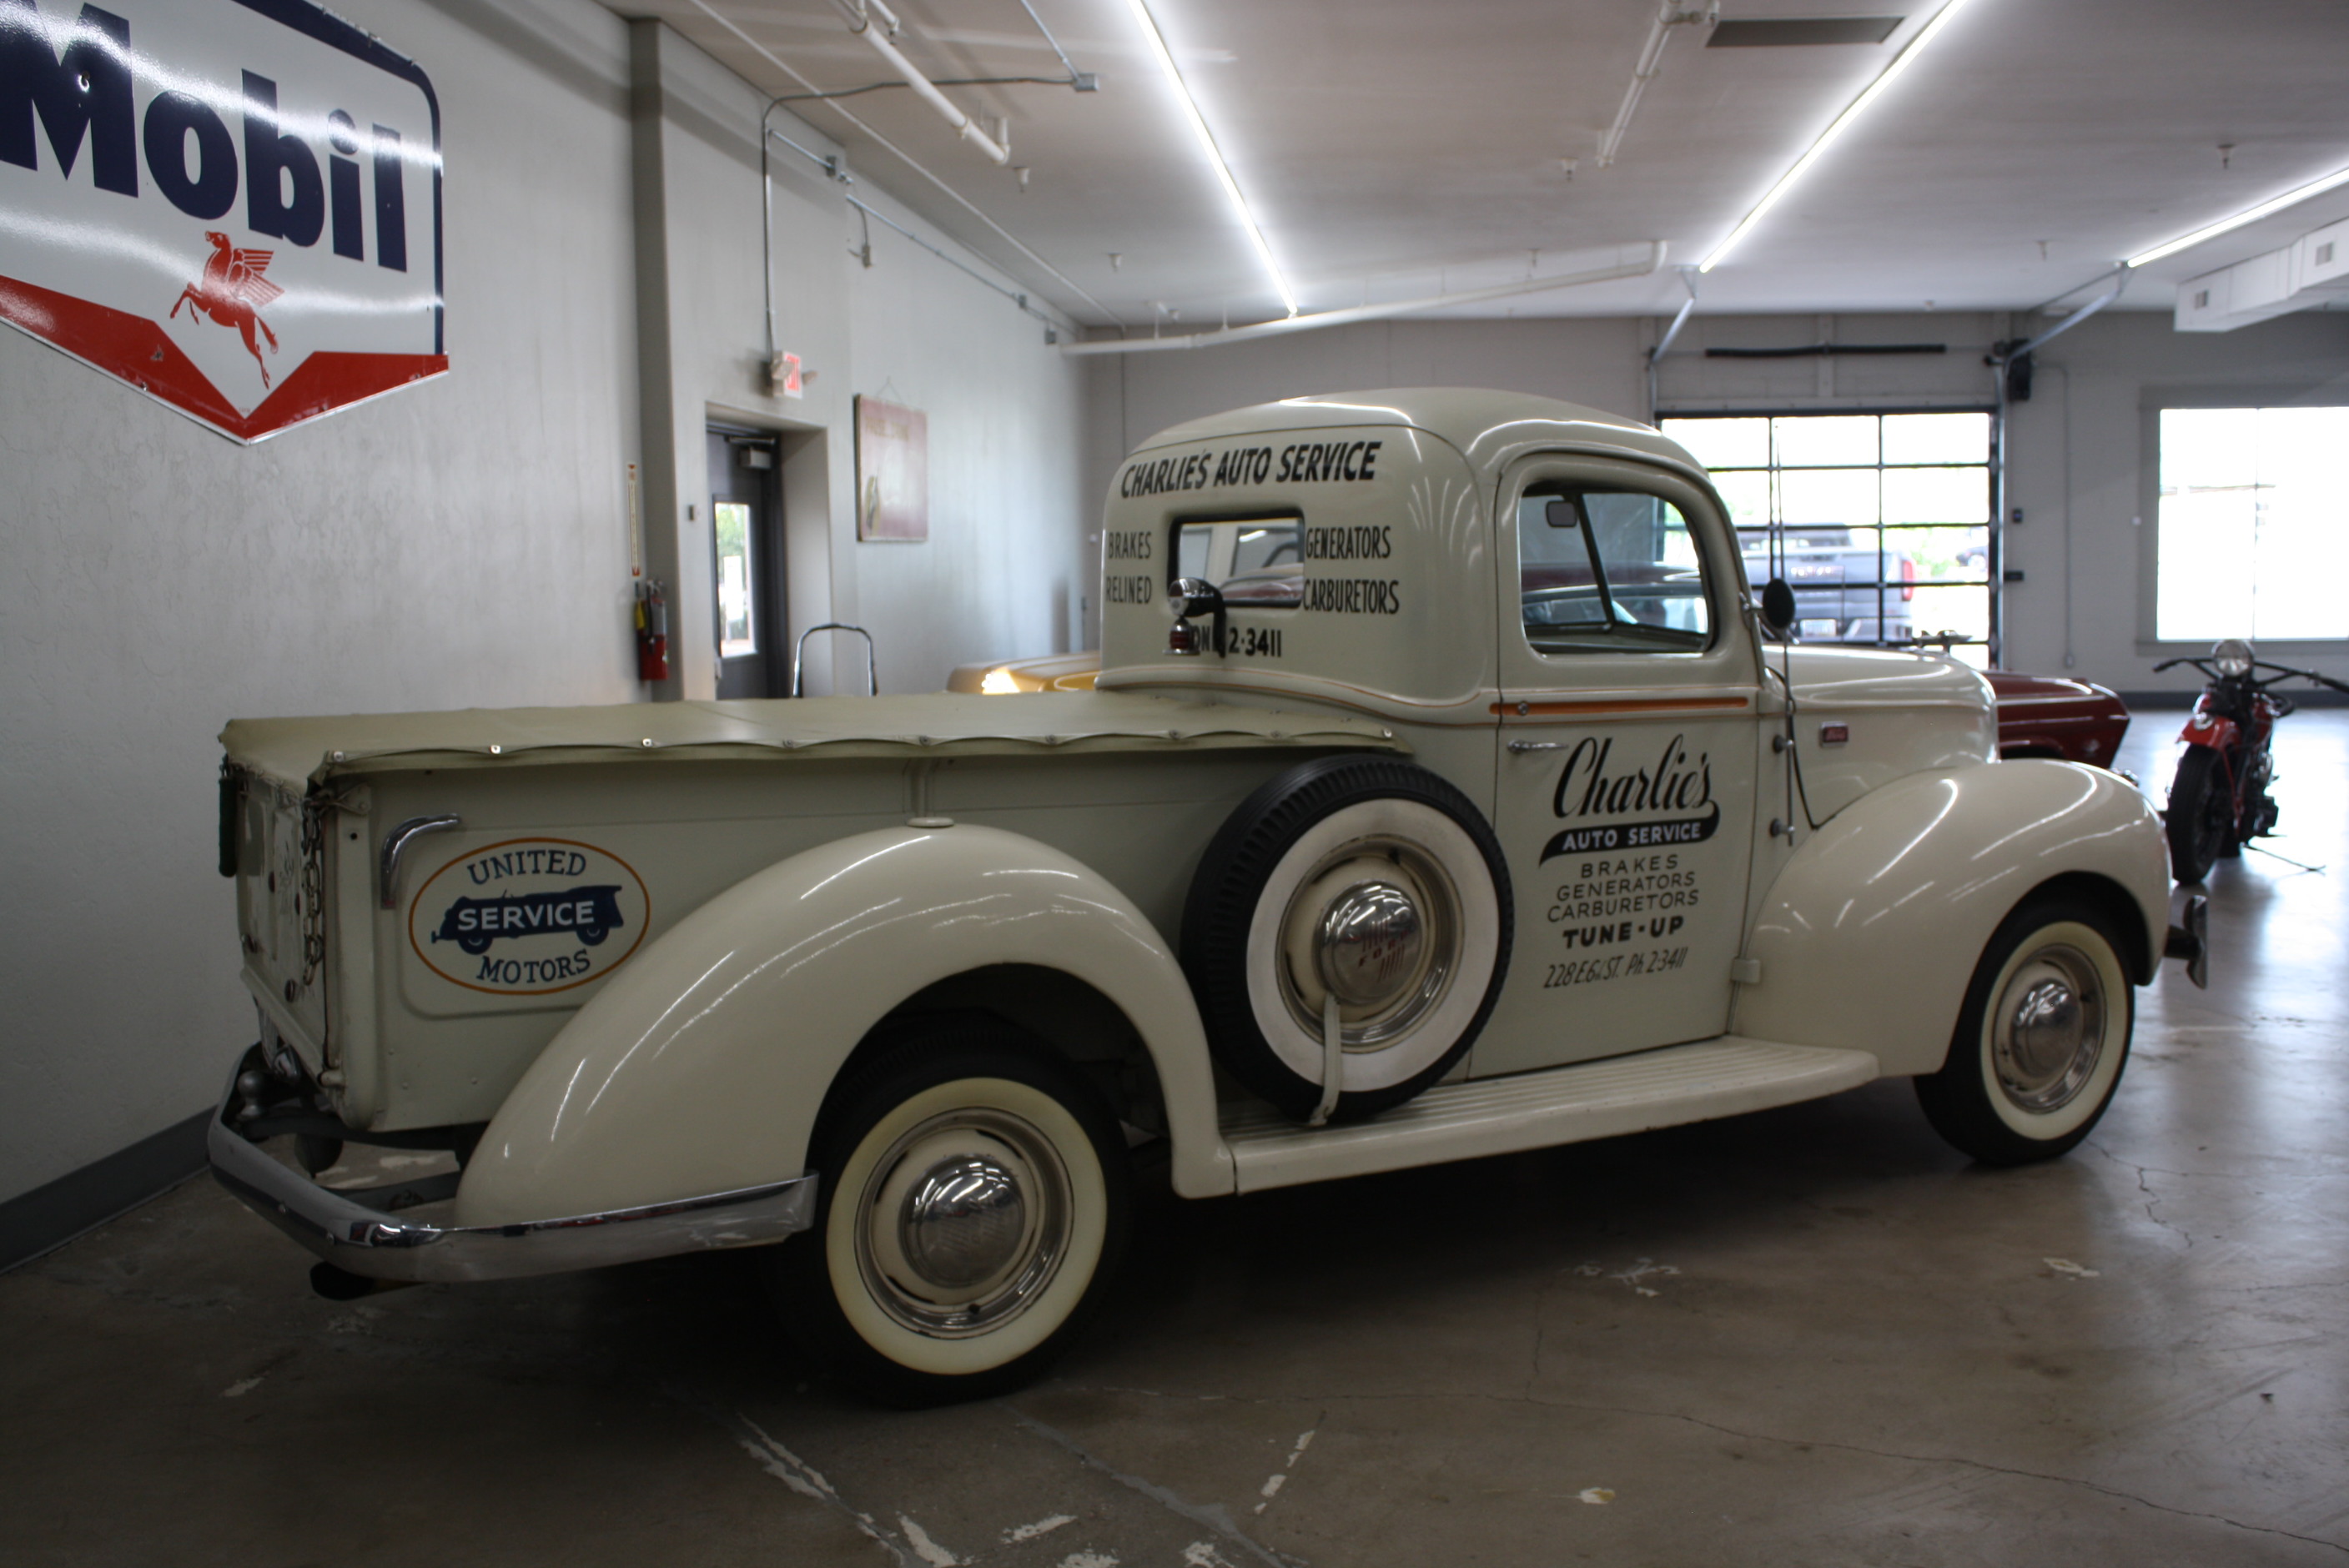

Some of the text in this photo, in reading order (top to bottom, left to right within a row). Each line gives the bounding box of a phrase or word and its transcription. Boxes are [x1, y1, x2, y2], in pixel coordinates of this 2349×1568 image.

[0, 0, 407, 273] Mobil
[1213, 446, 1273, 487] AUTO
[1276, 441, 1382, 482] SERVICE
[1108, 531, 1152, 560] BRAKES
[1305, 525, 1391, 560] GENERATORS
[1105, 576, 1152, 605] RELINED
[1303, 579, 1400, 615] CARBURETORS
[1553, 733, 1710, 819] Charlie's
[1562, 822, 1702, 852] AUTO SERVICE
[466, 849, 586, 885] UNITED
[1581, 854, 1678, 878] BRAKES
[1557, 871, 1695, 902] GENERATORS
[457, 901, 595, 931] SERVICE
[1547, 889, 1699, 922] CARBURETORS
[476, 948, 591, 984] MOTORS
